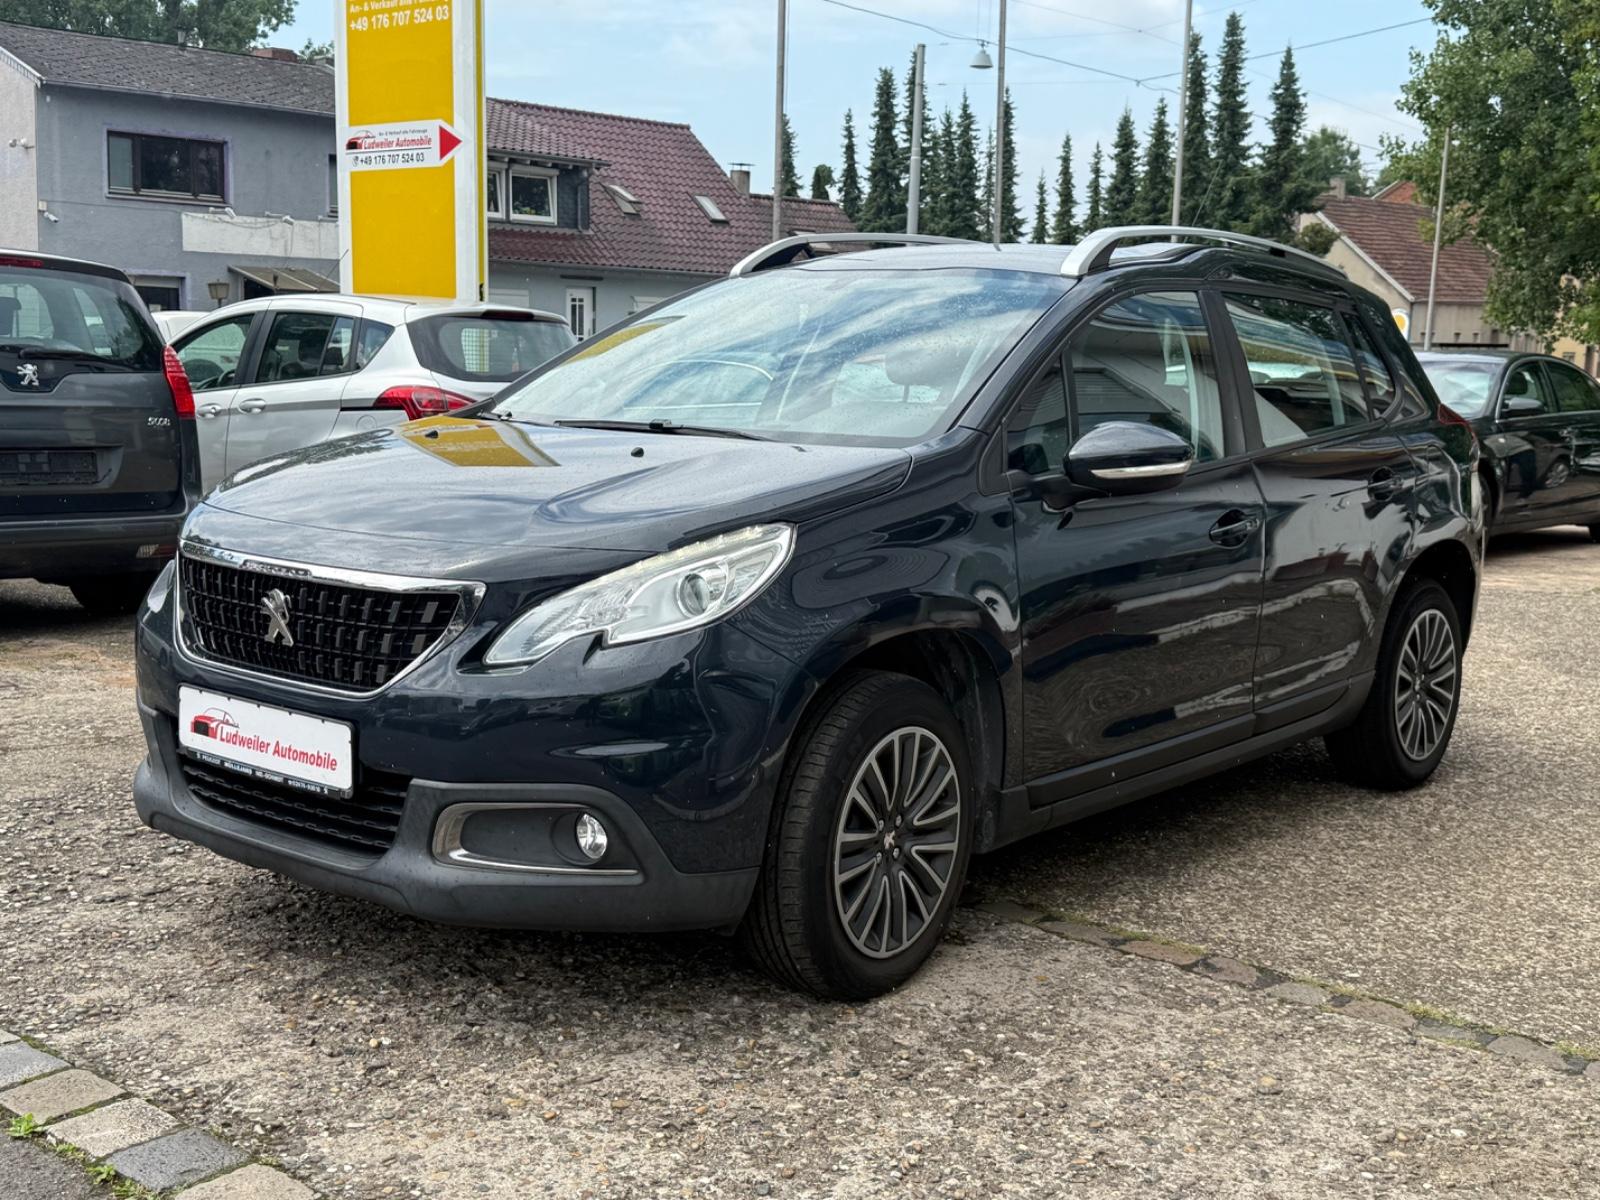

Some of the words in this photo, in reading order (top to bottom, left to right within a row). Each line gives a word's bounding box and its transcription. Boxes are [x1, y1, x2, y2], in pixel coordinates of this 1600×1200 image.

[350, 16, 368, 31] +49
[371, 13, 390, 30] 176
[392, 10, 411, 27] 707
[414, 7, 433, 24] 524
[436, 5, 449, 21] 03
[363, 137, 394, 149] Ludweiler
[395, 134, 432, 148] Automobile
[360, 155, 372, 165] +49
[374, 154, 386, 164] 176
[388, 153, 400, 164] 707
[402, 153, 414, 163] 524
[416, 152, 425, 162] 03
[219, 726, 271, 754] Ludweiler
[272, 740, 338, 772] Automobile
